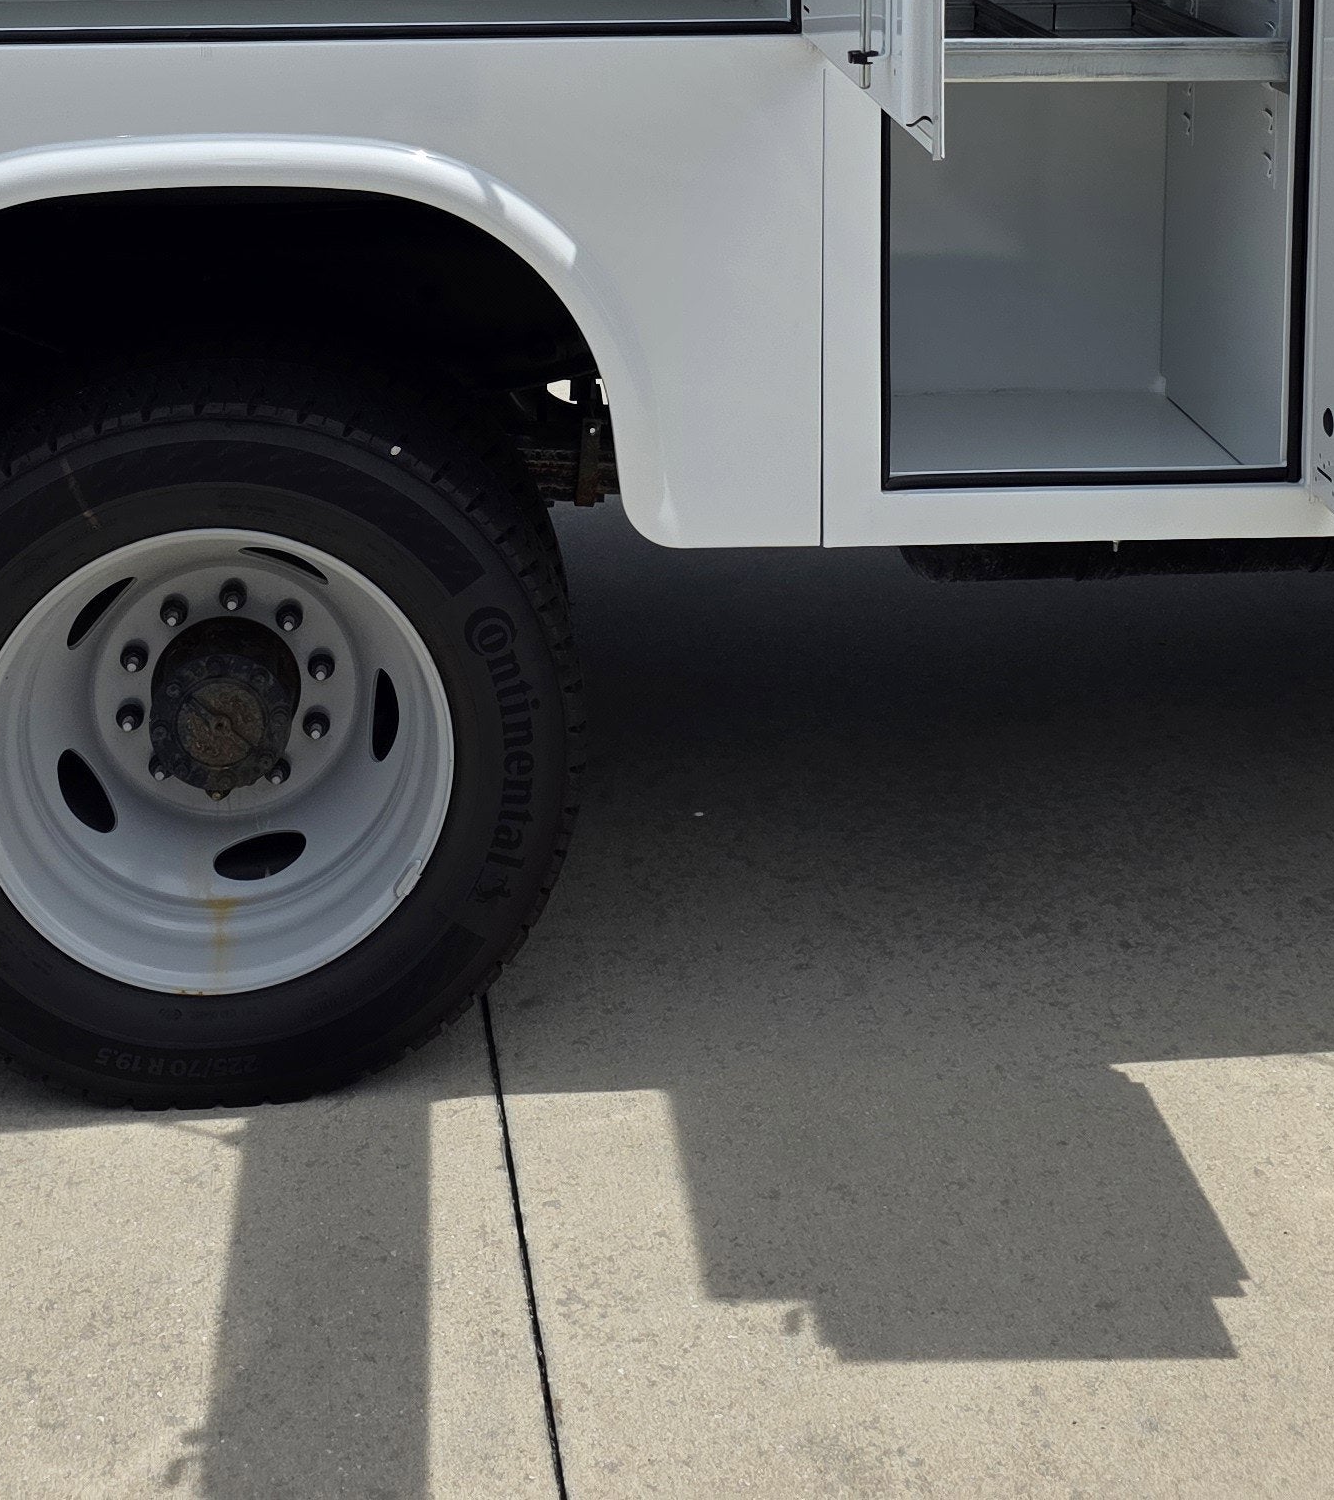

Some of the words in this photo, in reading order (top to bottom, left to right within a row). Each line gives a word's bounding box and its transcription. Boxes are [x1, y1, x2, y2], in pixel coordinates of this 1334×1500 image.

[464, 605, 541, 870] Continental
[94, 1047, 143, 1073] 19.5
[147, 1056, 166, 1076] R
